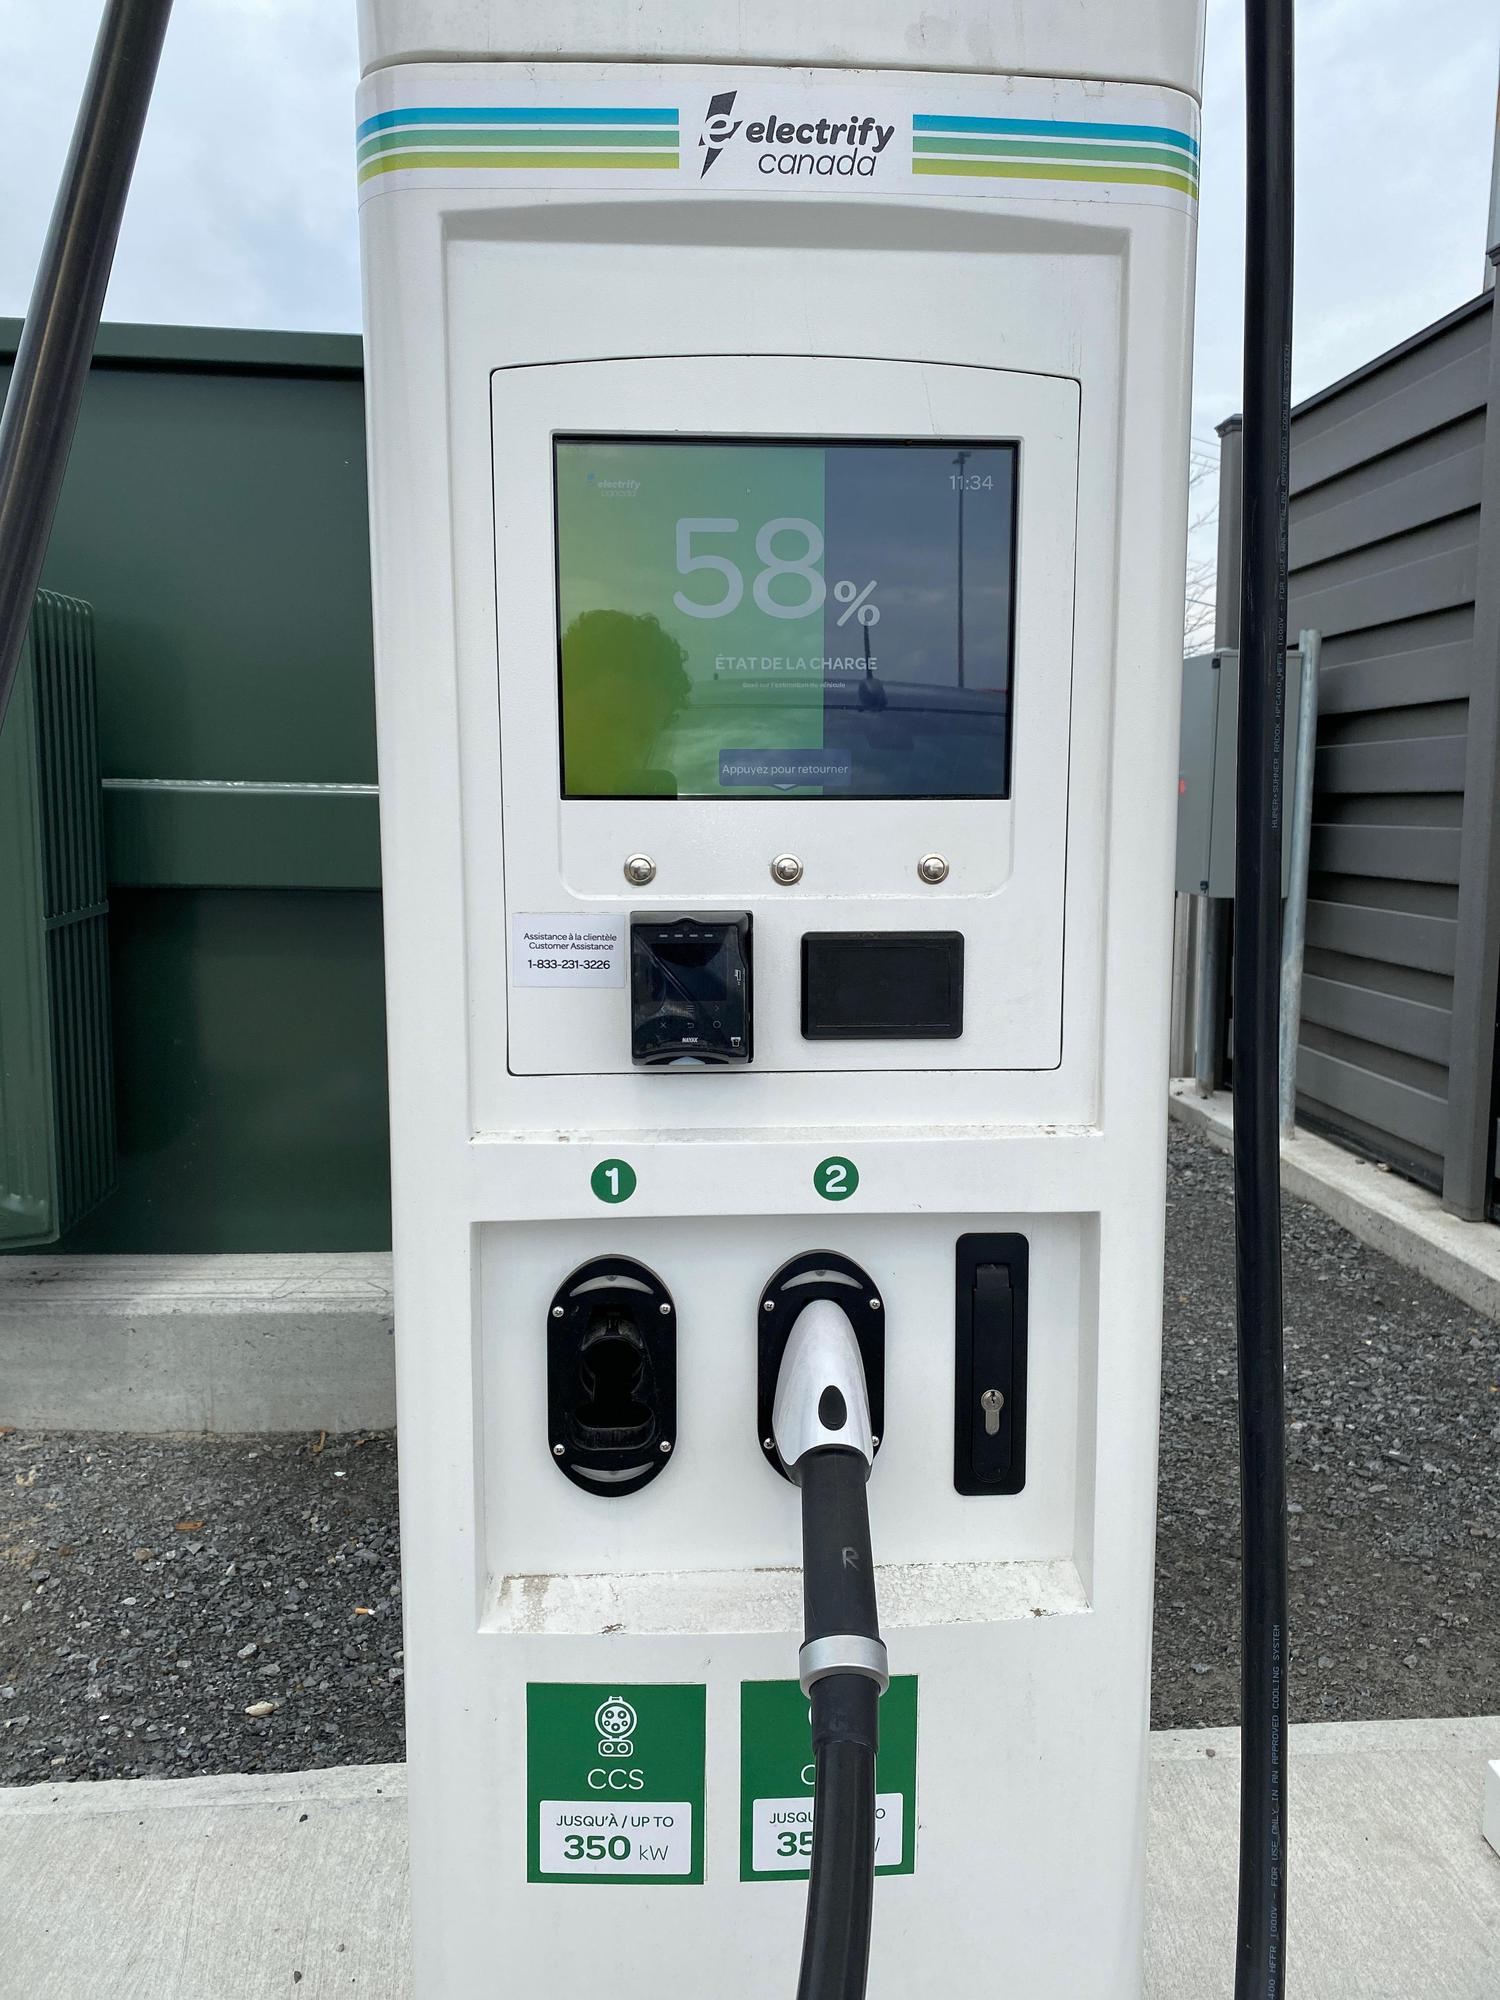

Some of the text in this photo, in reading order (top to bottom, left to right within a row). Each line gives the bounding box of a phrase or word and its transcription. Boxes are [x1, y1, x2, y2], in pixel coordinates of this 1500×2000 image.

[745, 115, 895, 153] electrify
[758, 147, 877, 177] canada
[949, 475, 994, 490] 11:34
[715, 654, 878, 670] ÉTAT DE LA CHARGE
[722, 764, 849, 775] Appuyez pour retourner
[523, 932, 617, 942] Assistance à la clientèle
[528, 942, 614, 950] Customer Assistance
[528, 959, 611, 969] 1-833-231-3226
[605, 1167, 619, 1196] 1
[825, 1164, 848, 1193] 2
[1272, 1624, 1280, 1661] SYSTEM
[1272, 1666, 1280, 1710] COOLING
[1271, 1714, 1279, 1765] APPROVED
[587, 1768, 645, 1790] CCS
[1271, 1770, 1279, 1784] AN
[1271, 1789, 1279, 1801] IN
[556, 1813, 674, 1829] JUSQU'À / UP TO
[1271, 1808, 1279, 1835] ONLY
[563, 1834, 669, 1861] 350 kW
[776, 1831, 813, 1857] 35
[1271, 1840, 1279, 1861] USE
[1270, 1866, 1278, 1887] FOR
[1269, 1905, 1278, 1938] 1000V
[1268, 1945, 1277, 1973] HFFR
